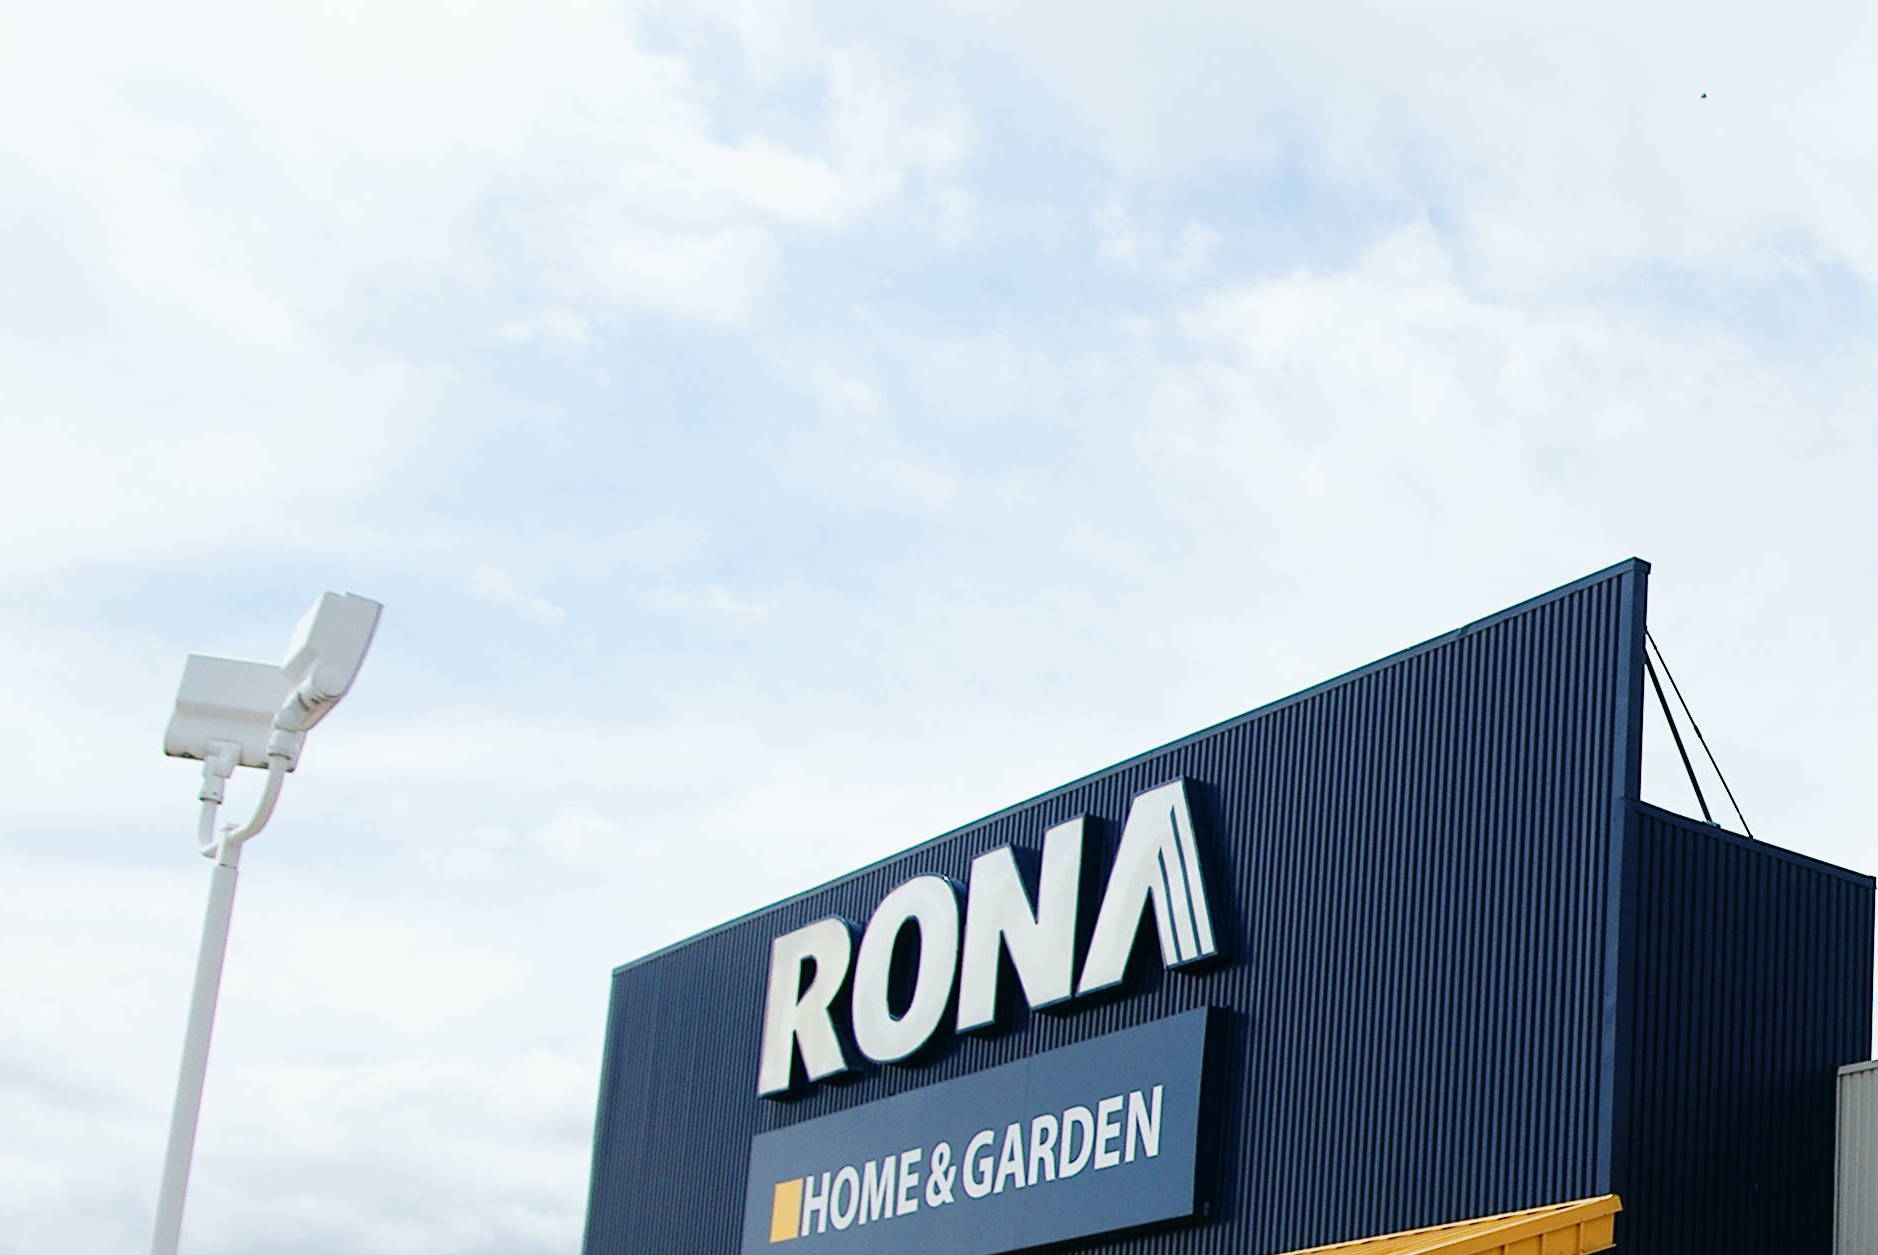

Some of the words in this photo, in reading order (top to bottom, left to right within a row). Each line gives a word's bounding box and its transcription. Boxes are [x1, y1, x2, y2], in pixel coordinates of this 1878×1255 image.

[758, 775, 1220, 1098] RONA
[800, 1147, 922, 1237] HOME
[925, 1141, 956, 1208] &
[962, 1084, 1164, 1199] GARDEN
